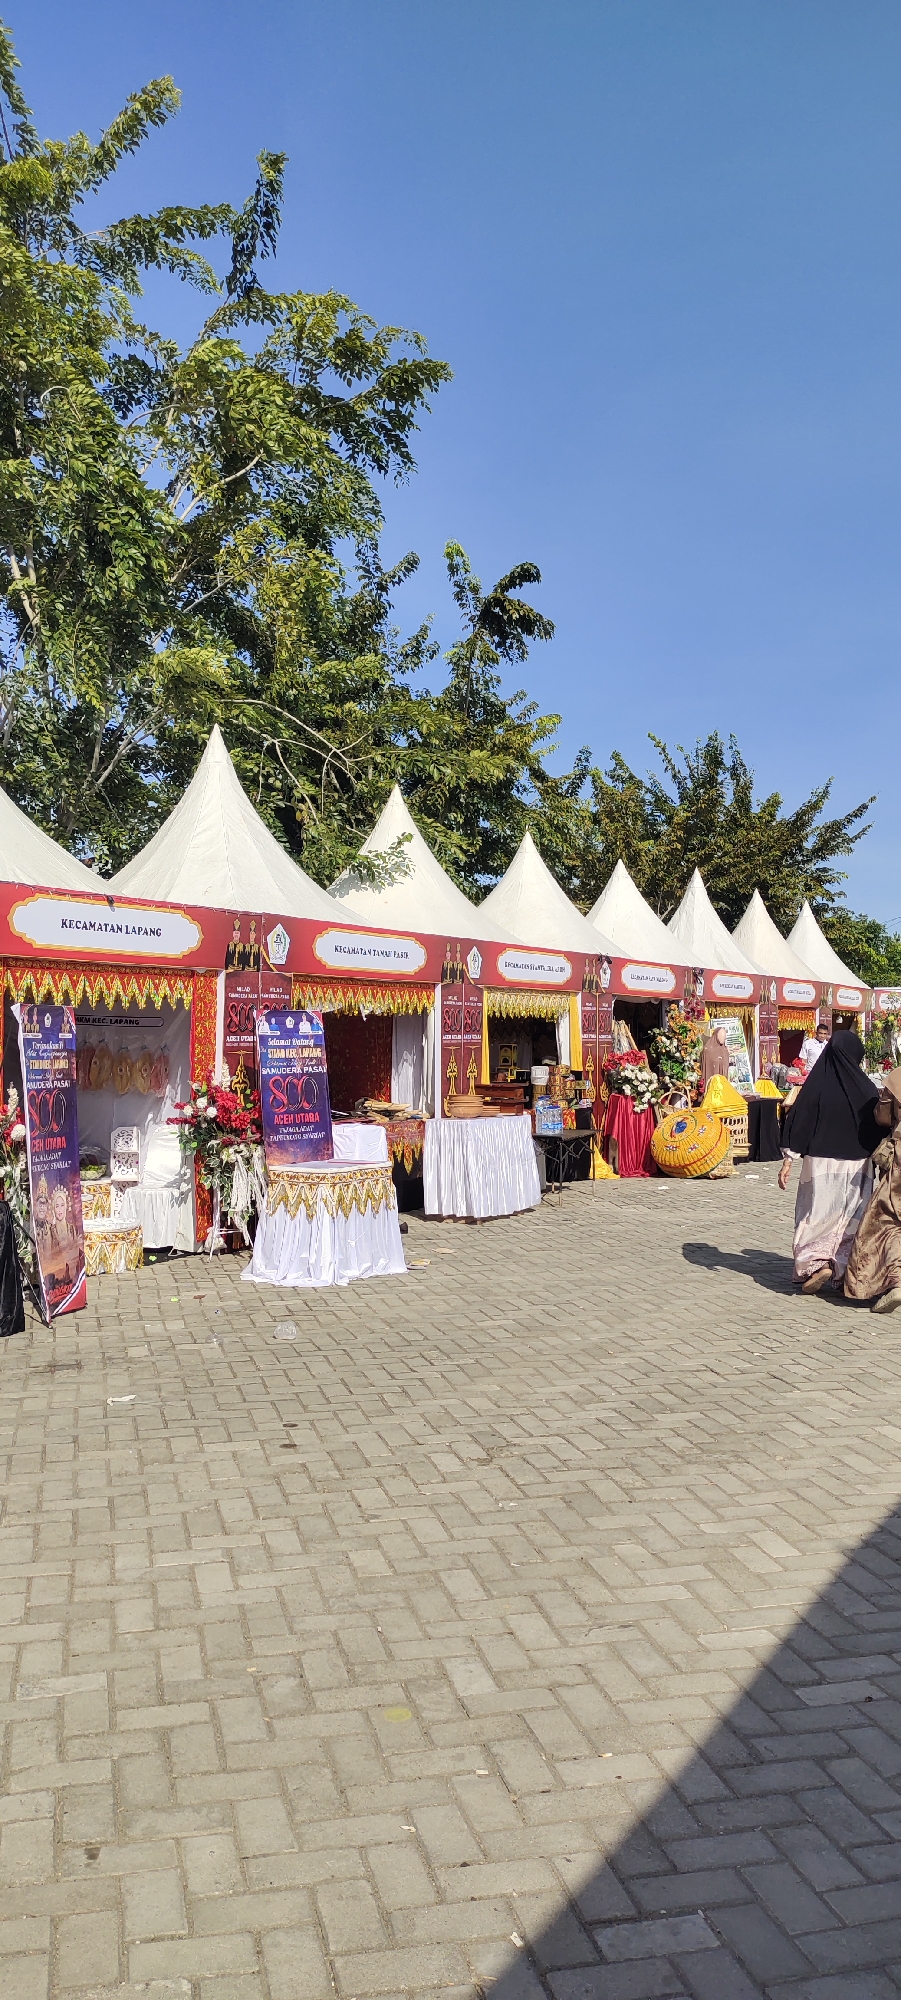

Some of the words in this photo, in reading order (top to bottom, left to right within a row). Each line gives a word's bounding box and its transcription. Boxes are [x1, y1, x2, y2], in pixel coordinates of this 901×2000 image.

[61, 918, 123, 934] KECAMATAN
[125, 924, 162, 937] LAPANG
[334, 944, 372, 956] KECAMATAN
[109, 1018, 140, 1026] LAPANG
[267, 1037, 291, 1046] Selamat
[268, 1048, 285, 1059] STAND
[299, 1047, 322, 1058] LAPANG
[262, 1066, 302, 1075] SAMUDERA
[303, 1065, 327, 1074] PASAI
[26, 1080, 54, 1089] AMUDERA
[273, 1113, 294, 1125] ACEH
[295, 1111, 320, 1124] UTARA
[31, 1139, 44, 1153] CEH
[45, 1136, 67, 1151] UTARA
